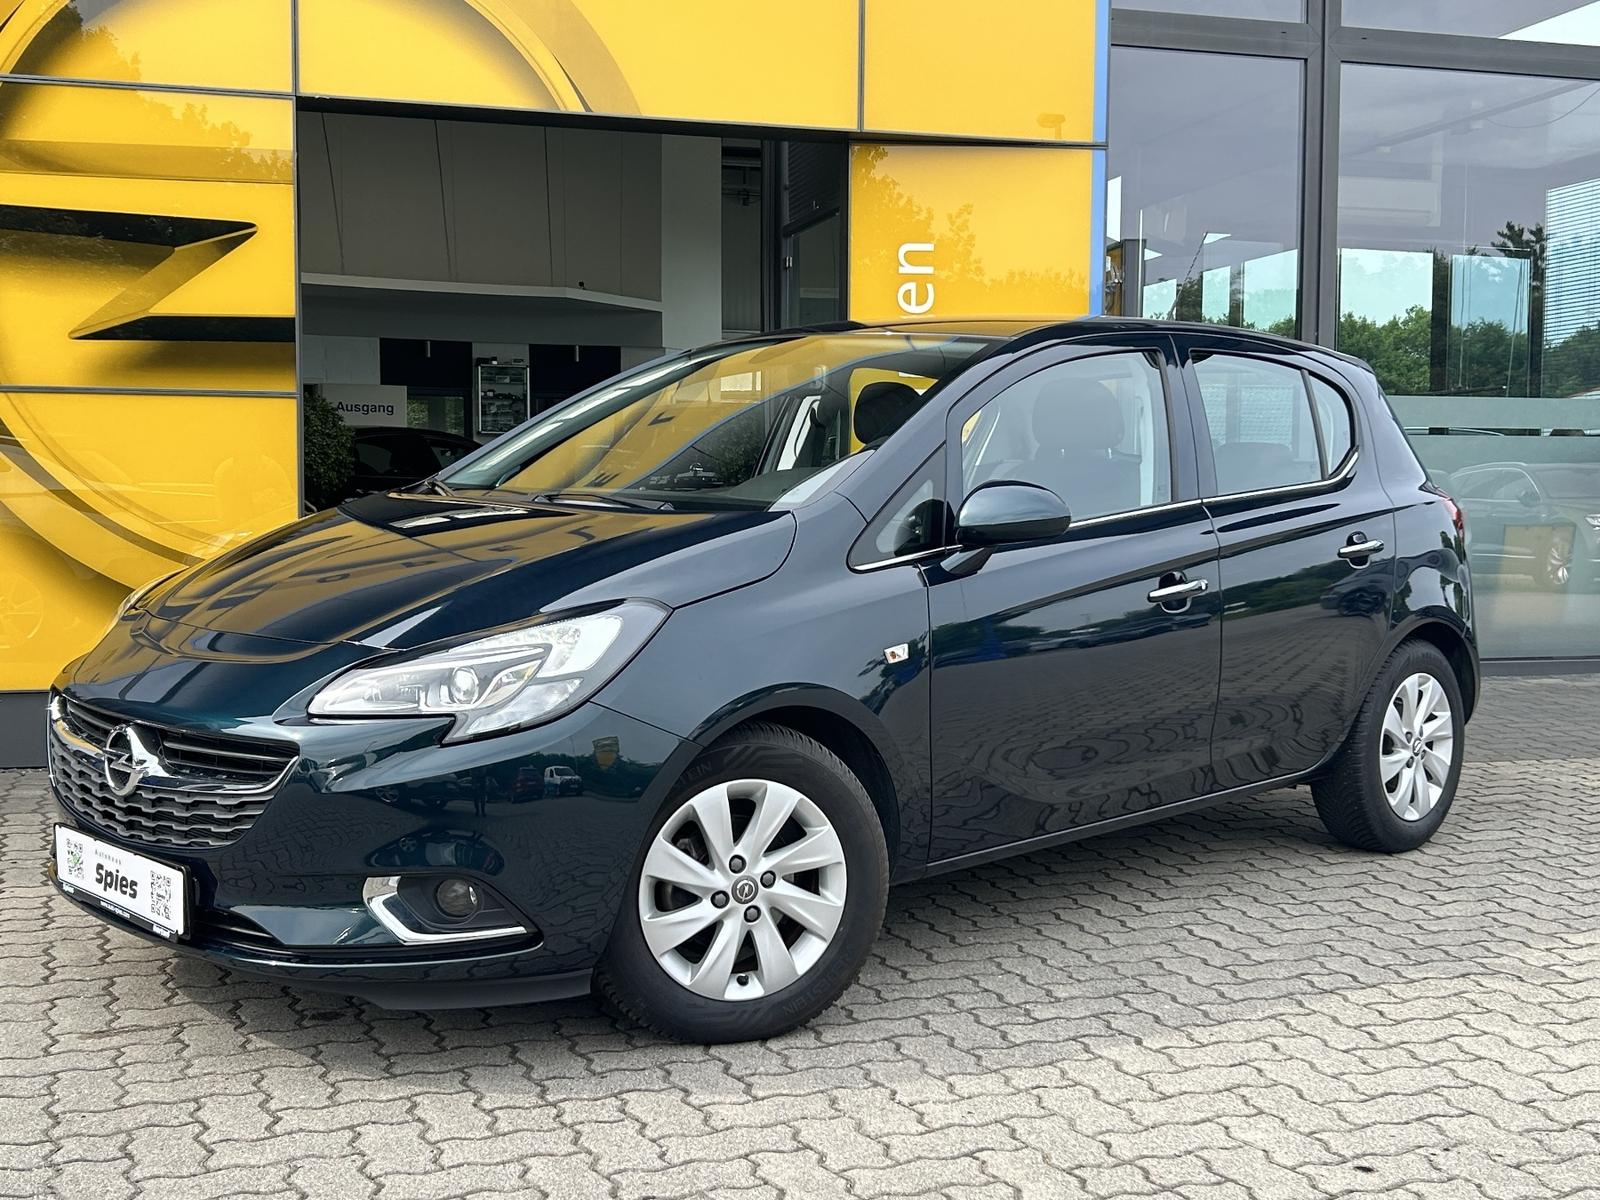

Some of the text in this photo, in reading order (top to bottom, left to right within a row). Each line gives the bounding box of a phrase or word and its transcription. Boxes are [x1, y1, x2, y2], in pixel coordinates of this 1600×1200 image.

[897, 242, 935, 318] en
[336, 401, 394, 416] Ausgang
[95, 862, 138, 899] Spies
